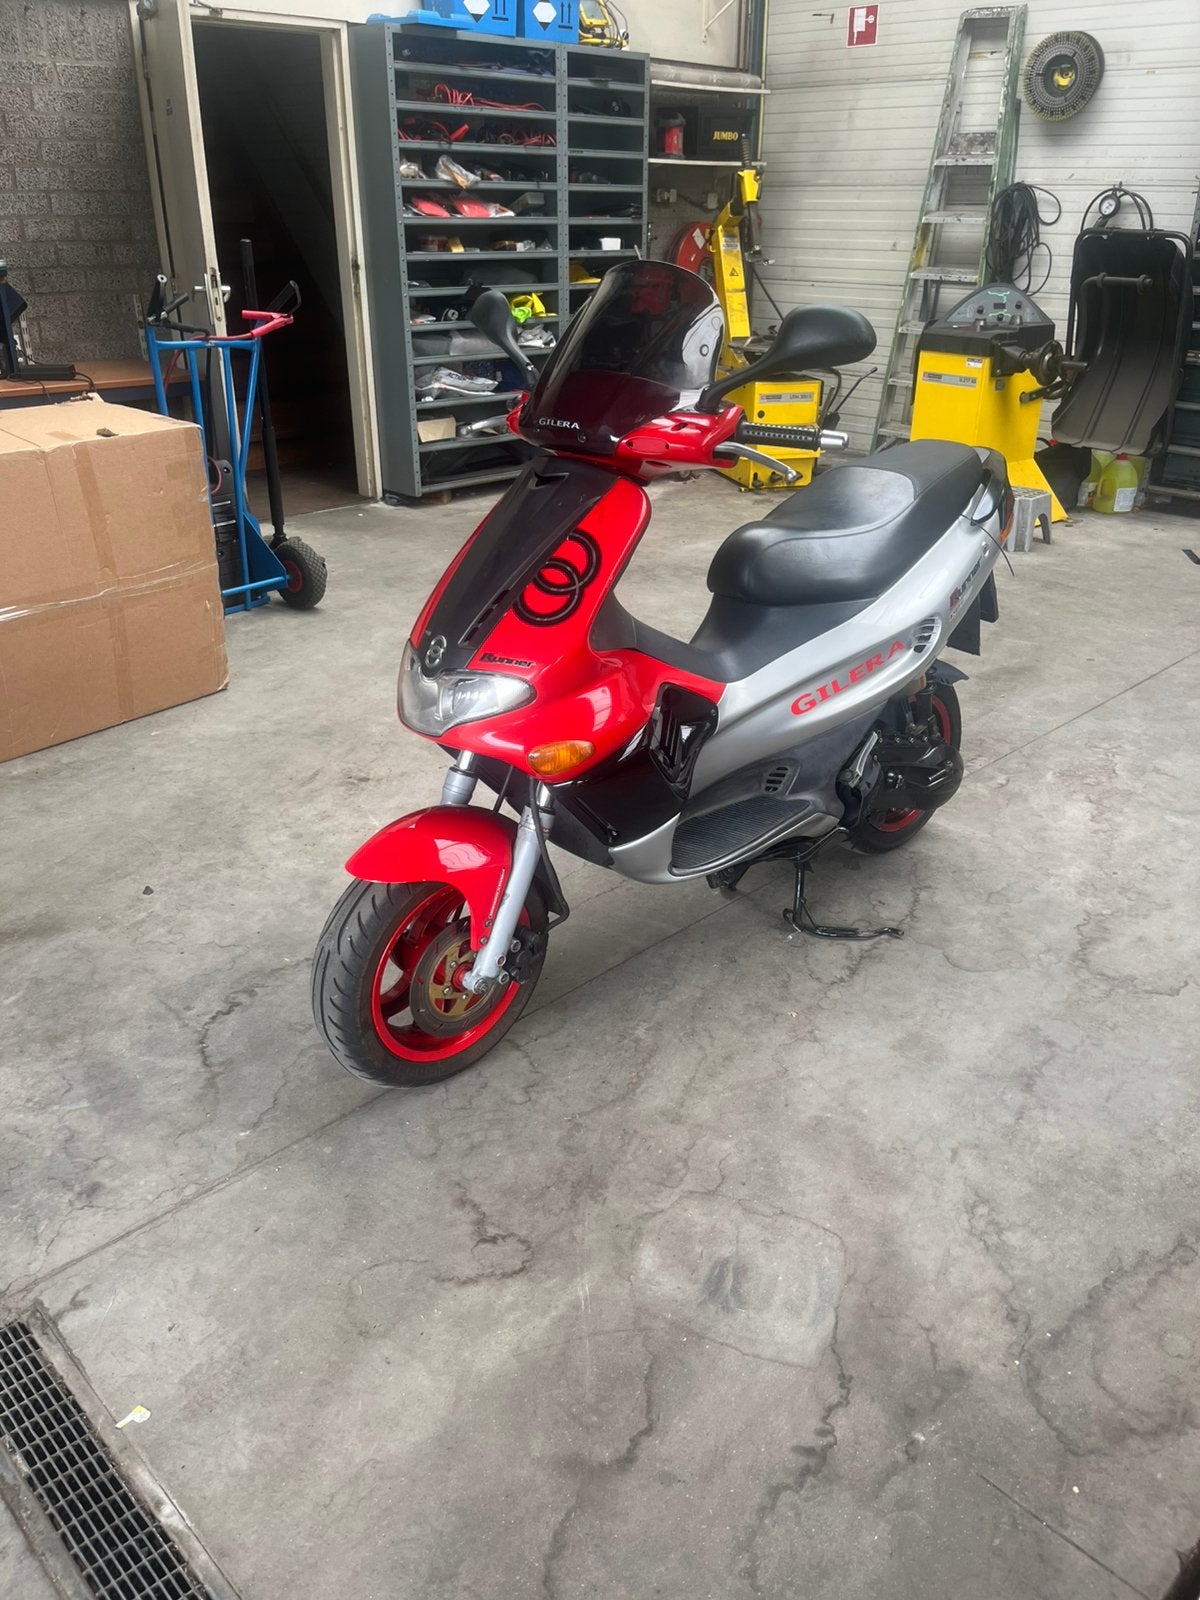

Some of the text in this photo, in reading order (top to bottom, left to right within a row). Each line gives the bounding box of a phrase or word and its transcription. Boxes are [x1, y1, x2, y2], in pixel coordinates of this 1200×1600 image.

[713, 131, 739, 141] JUMBO
[538, 417, 580, 430] GILERA
[948, 555, 983, 609] Runner
[480, 653, 534, 667] Runner
[790, 640, 906, 716] GILERA
